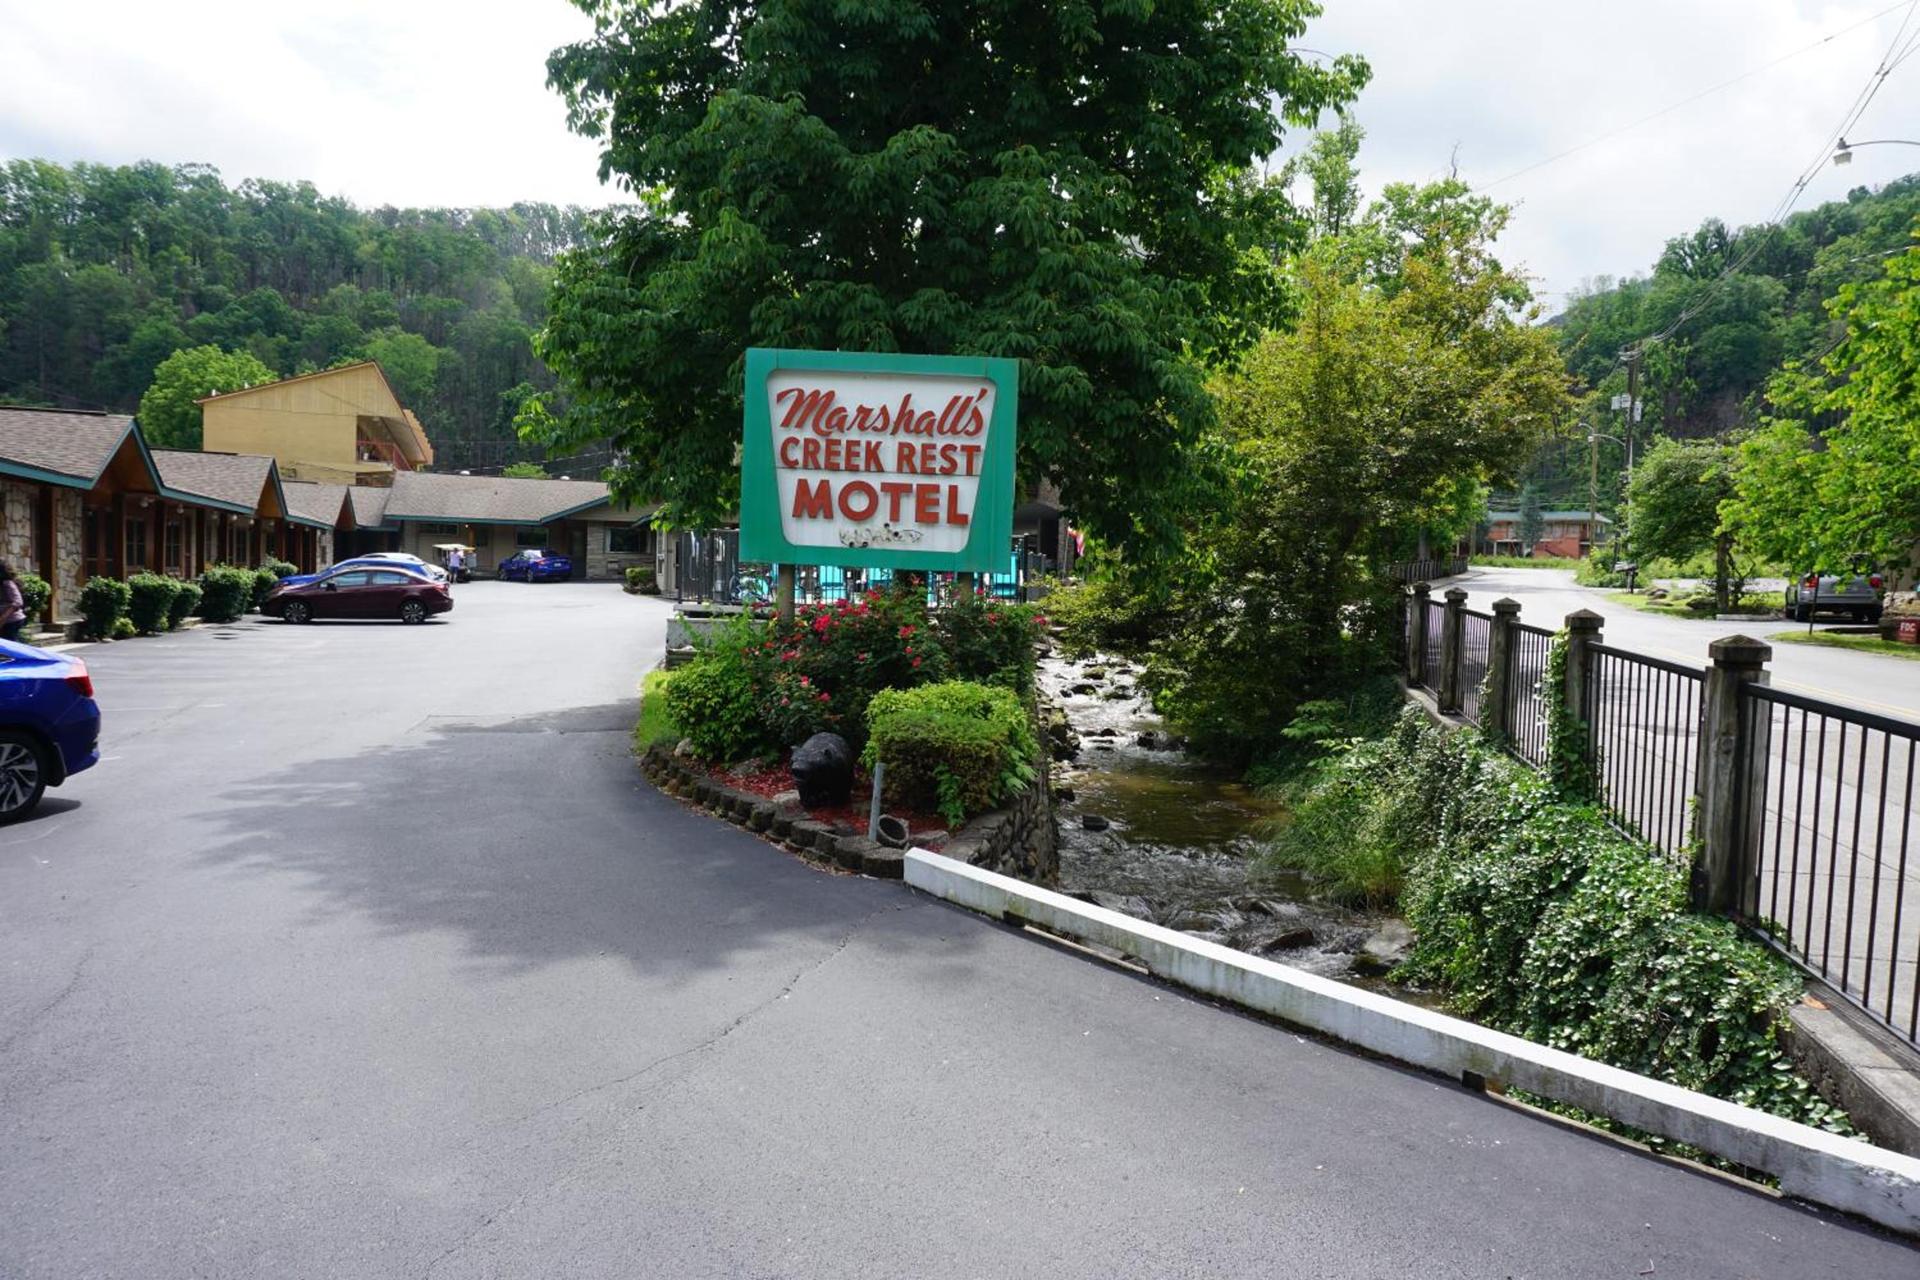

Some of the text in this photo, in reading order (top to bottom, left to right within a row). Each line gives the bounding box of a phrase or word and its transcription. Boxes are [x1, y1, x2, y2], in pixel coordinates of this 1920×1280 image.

[776, 387, 988, 437] Marshall's
[780, 436, 981, 477] CREEK REST
[792, 478, 969, 525] MOTEL
